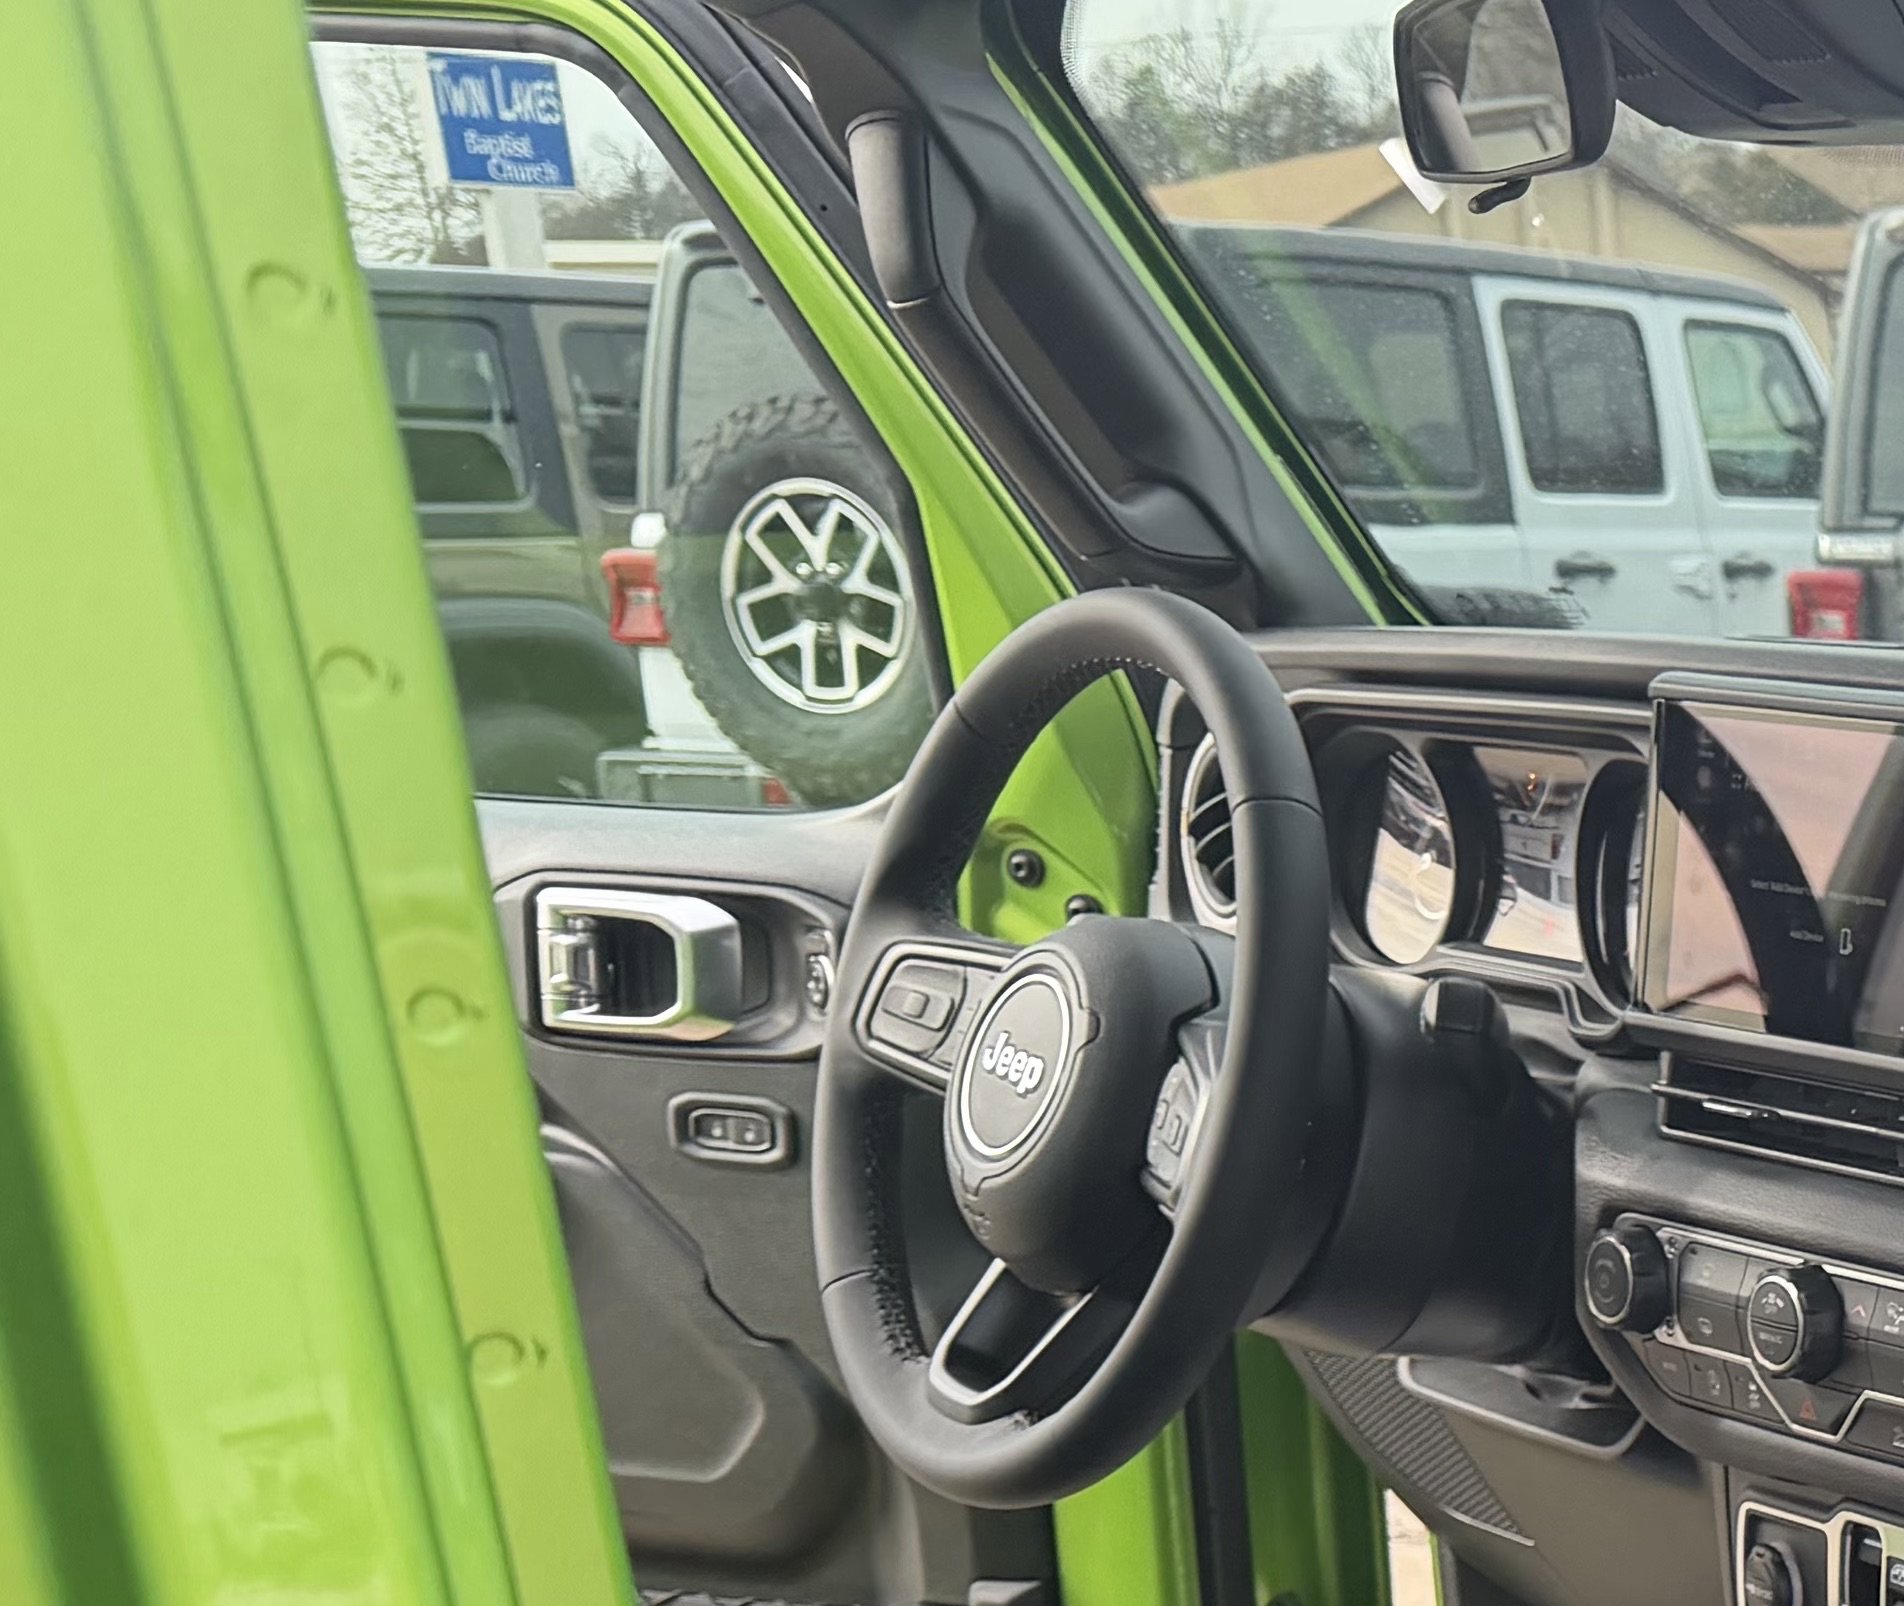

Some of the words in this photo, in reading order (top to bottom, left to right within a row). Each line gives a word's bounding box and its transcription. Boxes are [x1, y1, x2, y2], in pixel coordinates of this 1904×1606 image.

[463, 128, 535, 159] Baptist
[487, 158, 562, 184] Church
[982, 1031, 1044, 1098] Jeep
